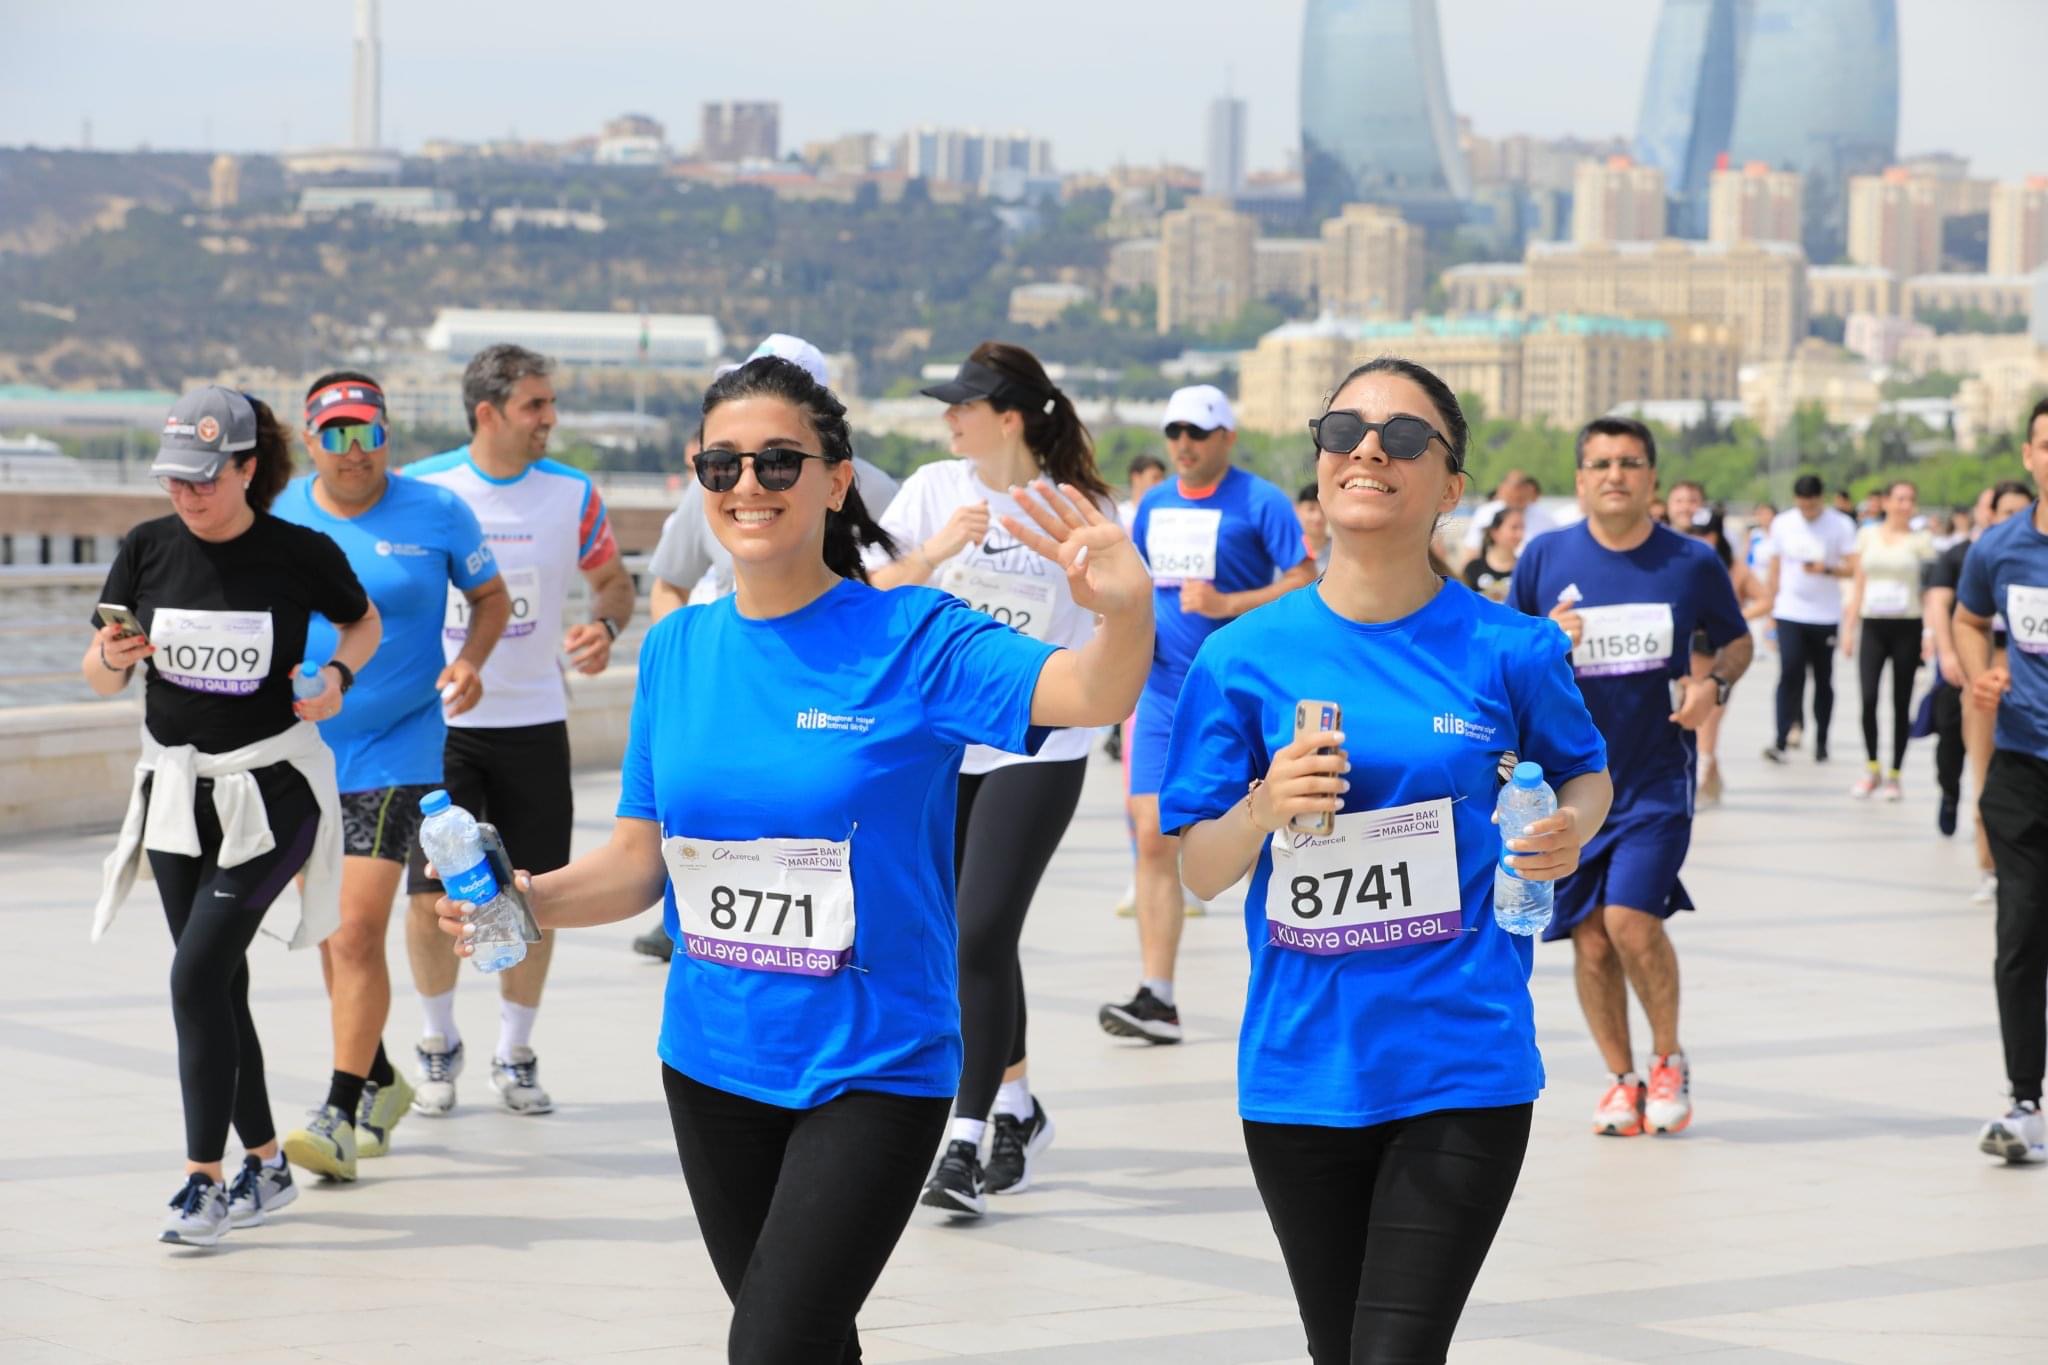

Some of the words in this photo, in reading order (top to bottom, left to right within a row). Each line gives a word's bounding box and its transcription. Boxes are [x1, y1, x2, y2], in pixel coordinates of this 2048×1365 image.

[162, 644, 260, 673] 10709
[1586, 632, 1659, 660] 11586
[1382, 820, 1439, 837] MARAFONU
[1415, 809, 1438, 821] BAKI
[819, 847, 842, 857] BAKI
[1311, 836, 1346, 848] Azercell
[788, 857, 842, 868] MARAFONU
[1290, 860, 1413, 919] 8741
[709, 884, 814, 938] 8771
[1277, 924, 1340, 949] KÜLƏYƏ
[1344, 921, 1403, 947] QALİB
[1407, 917, 1448, 938] GƏL
[688, 936, 748, 963] KÜLƏYƏ
[751, 947, 804, 968] QALİB
[806, 952, 841, 971] GƏL
